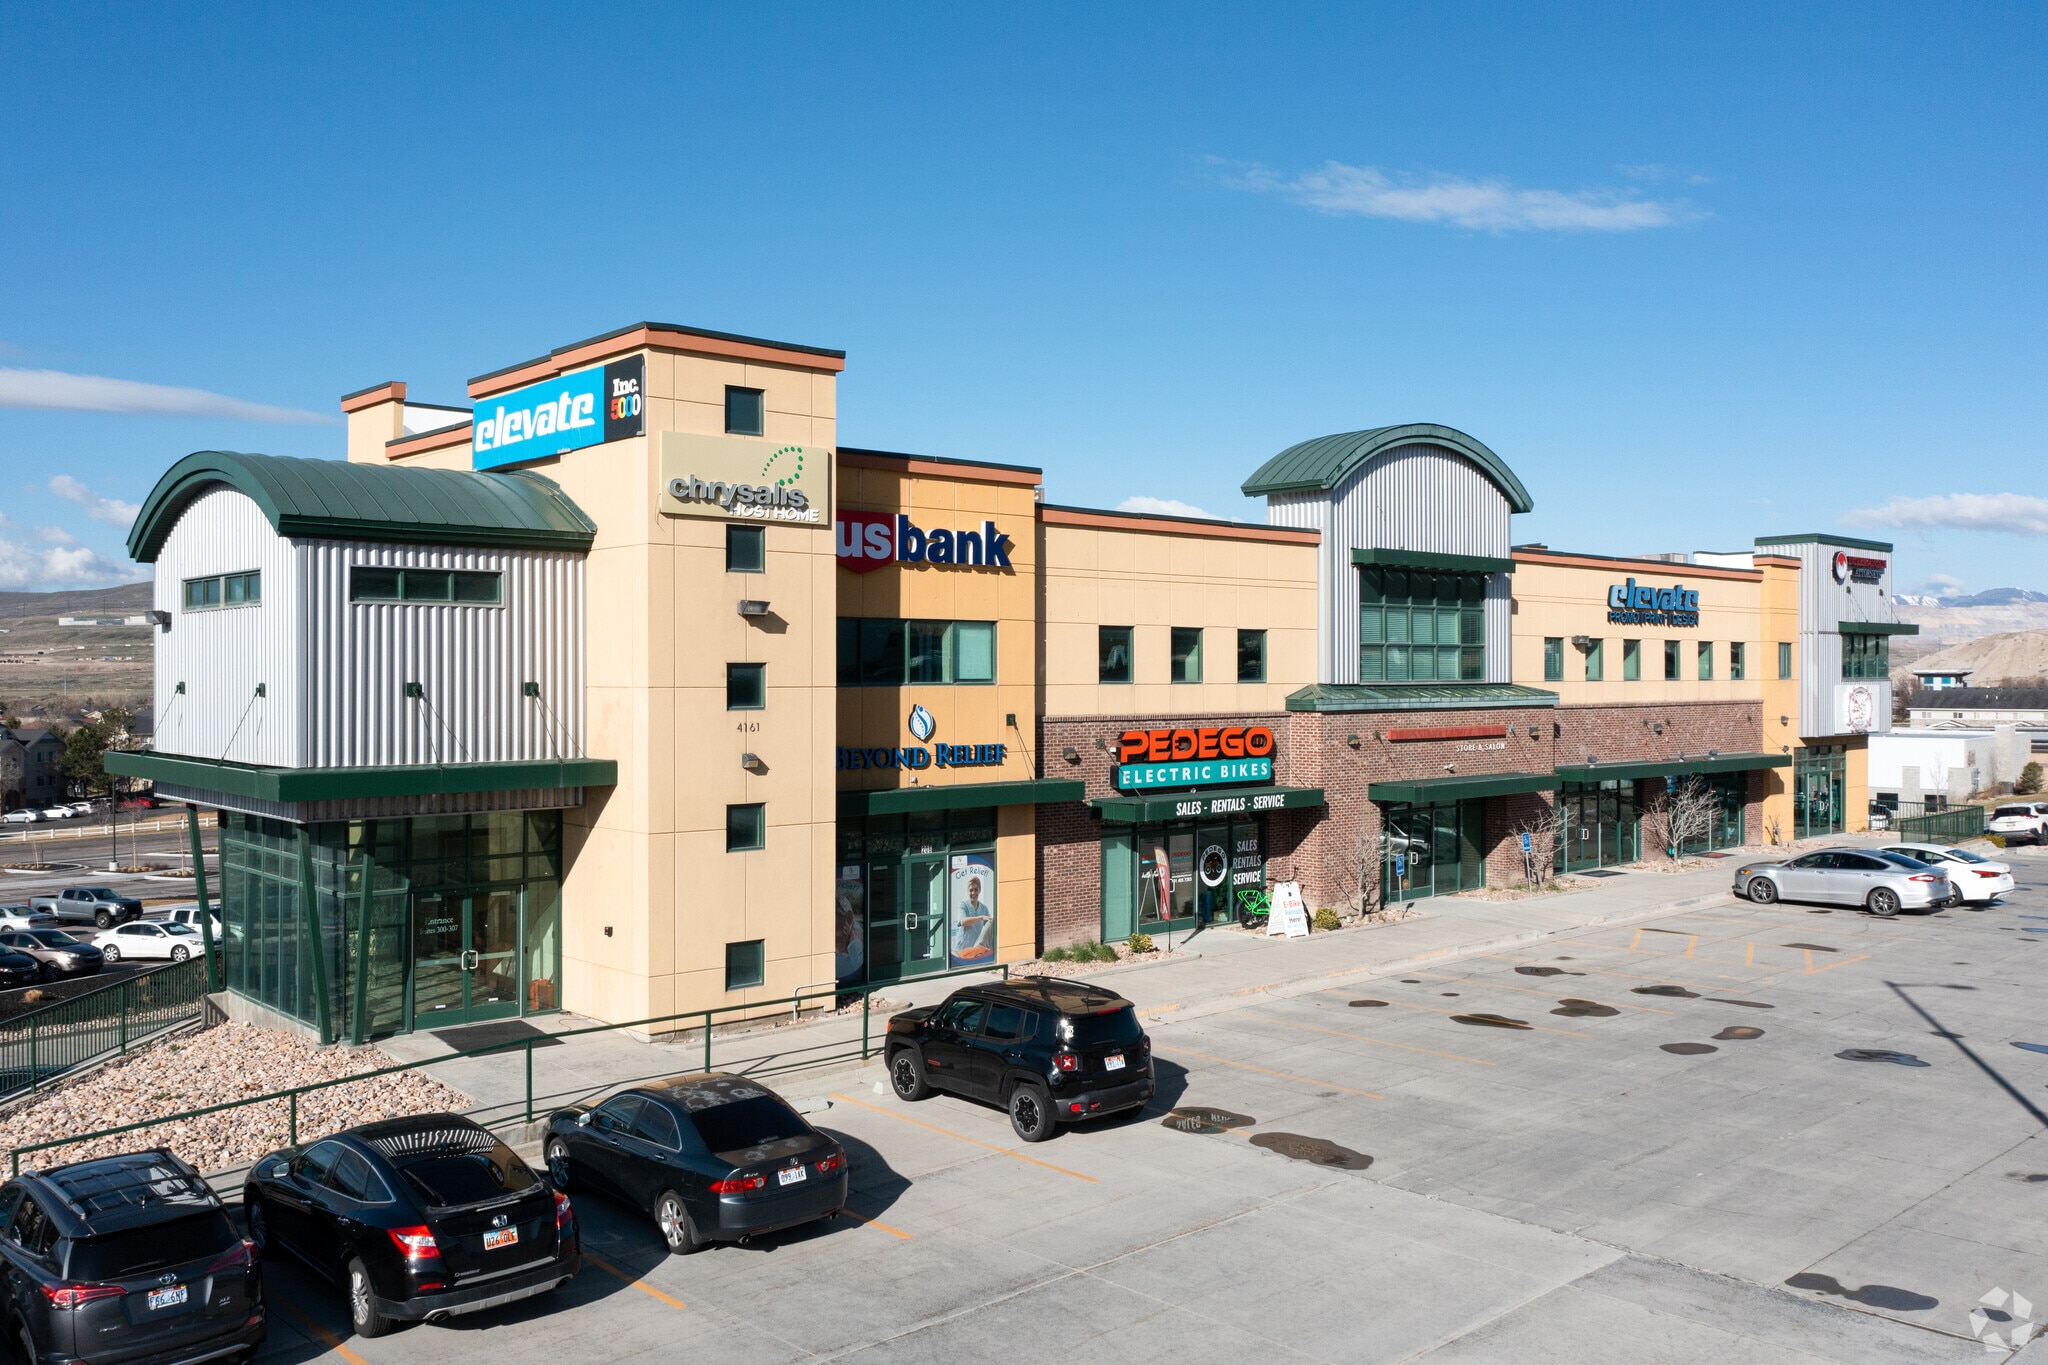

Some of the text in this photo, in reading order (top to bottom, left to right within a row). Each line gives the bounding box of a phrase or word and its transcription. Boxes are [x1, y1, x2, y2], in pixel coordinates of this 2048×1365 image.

[612, 378, 640, 397] Inc.
[610, 395, 642, 420] 5000
[475, 391, 596, 453] elevate
[668, 474, 805, 507] chrysalis
[729, 502, 820, 522] HOST HOME
[1608, 577, 1700, 612] elevate
[1608, 611, 1699, 626] PROMO PRINT DESIGN
[736, 722, 760, 733] 4161
[1120, 726, 1273, 763] PEDEGO
[1455, 743, 1476, 753] STORE
[1484, 742, 1505, 751] SALON
[836, 743, 1005, 770] BEYOND RELIEF
[1122, 763, 1268, 785] ELECTRIC BIKES
[1176, 794, 1285, 816] SALES RENTALS SERVICE
[1236, 839, 1258, 852] SALES
[1232, 855, 1262, 869] RENTALS
[955, 869, 968, 880] Get
[1232, 870, 1262, 886] SERVICE
